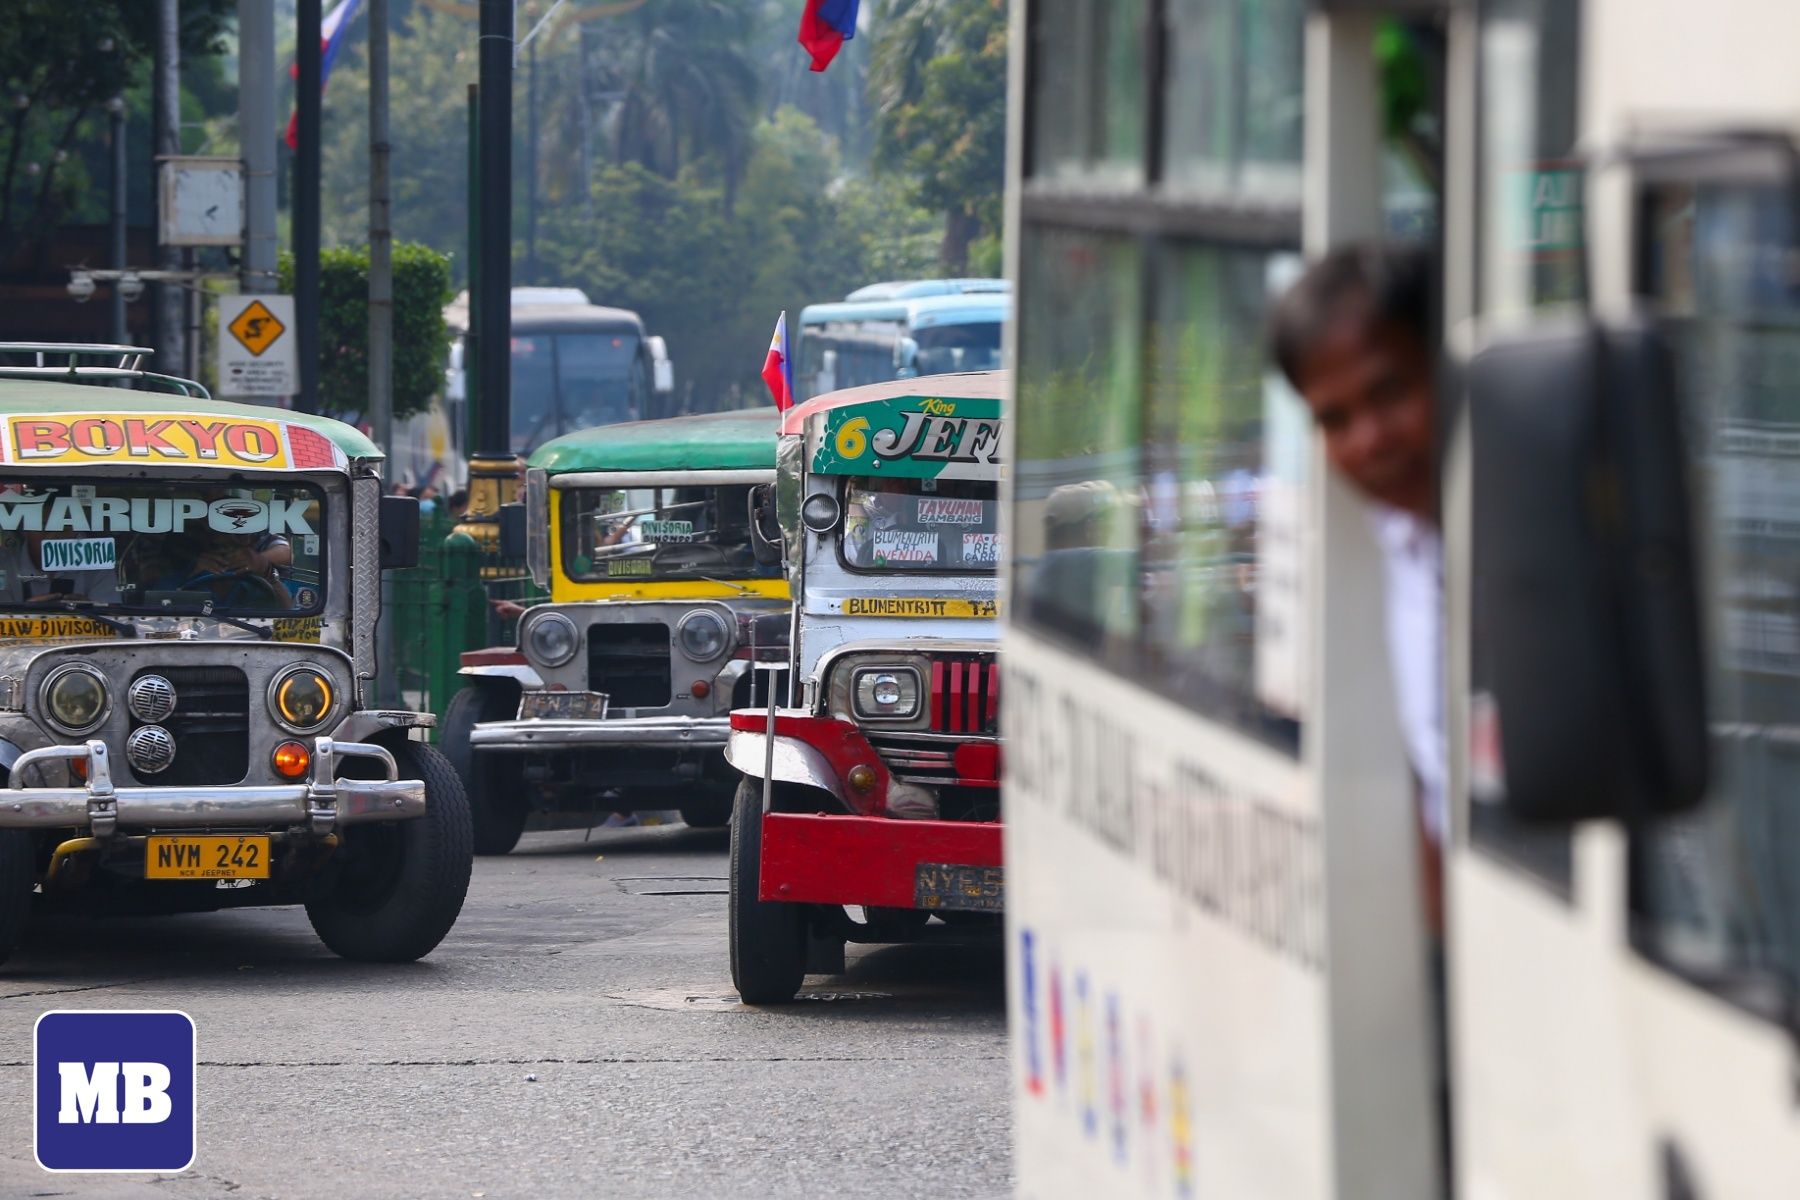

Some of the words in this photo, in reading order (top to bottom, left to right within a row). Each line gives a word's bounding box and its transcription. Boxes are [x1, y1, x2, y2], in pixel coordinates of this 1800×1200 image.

[918, 398, 956, 415] King
[14, 419, 279, 462] BOKYO
[835, 416, 871, 459] 6
[919, 500, 981, 514] TAYUMAN
[0, 497, 315, 535] MARUPOK
[919, 514, 981, 523] BAMBANG
[641, 522, 692, 534] DIVISORIA
[874, 531, 936, 544] BLUMENTRITT
[895, 543, 920, 551] LRT
[973, 542, 1001, 554] REC
[43, 541, 115, 568] DIVISORIA
[874, 549, 934, 561] AVENIDA
[964, 552, 1002, 562] CARR
[849, 598, 946, 616] BLUMENTRITT
[967, 600, 999, 616] TA
[158, 844, 201, 868] NVM
[216, 844, 259, 868] 242
[201, 869, 237, 877] JEEPNEY
